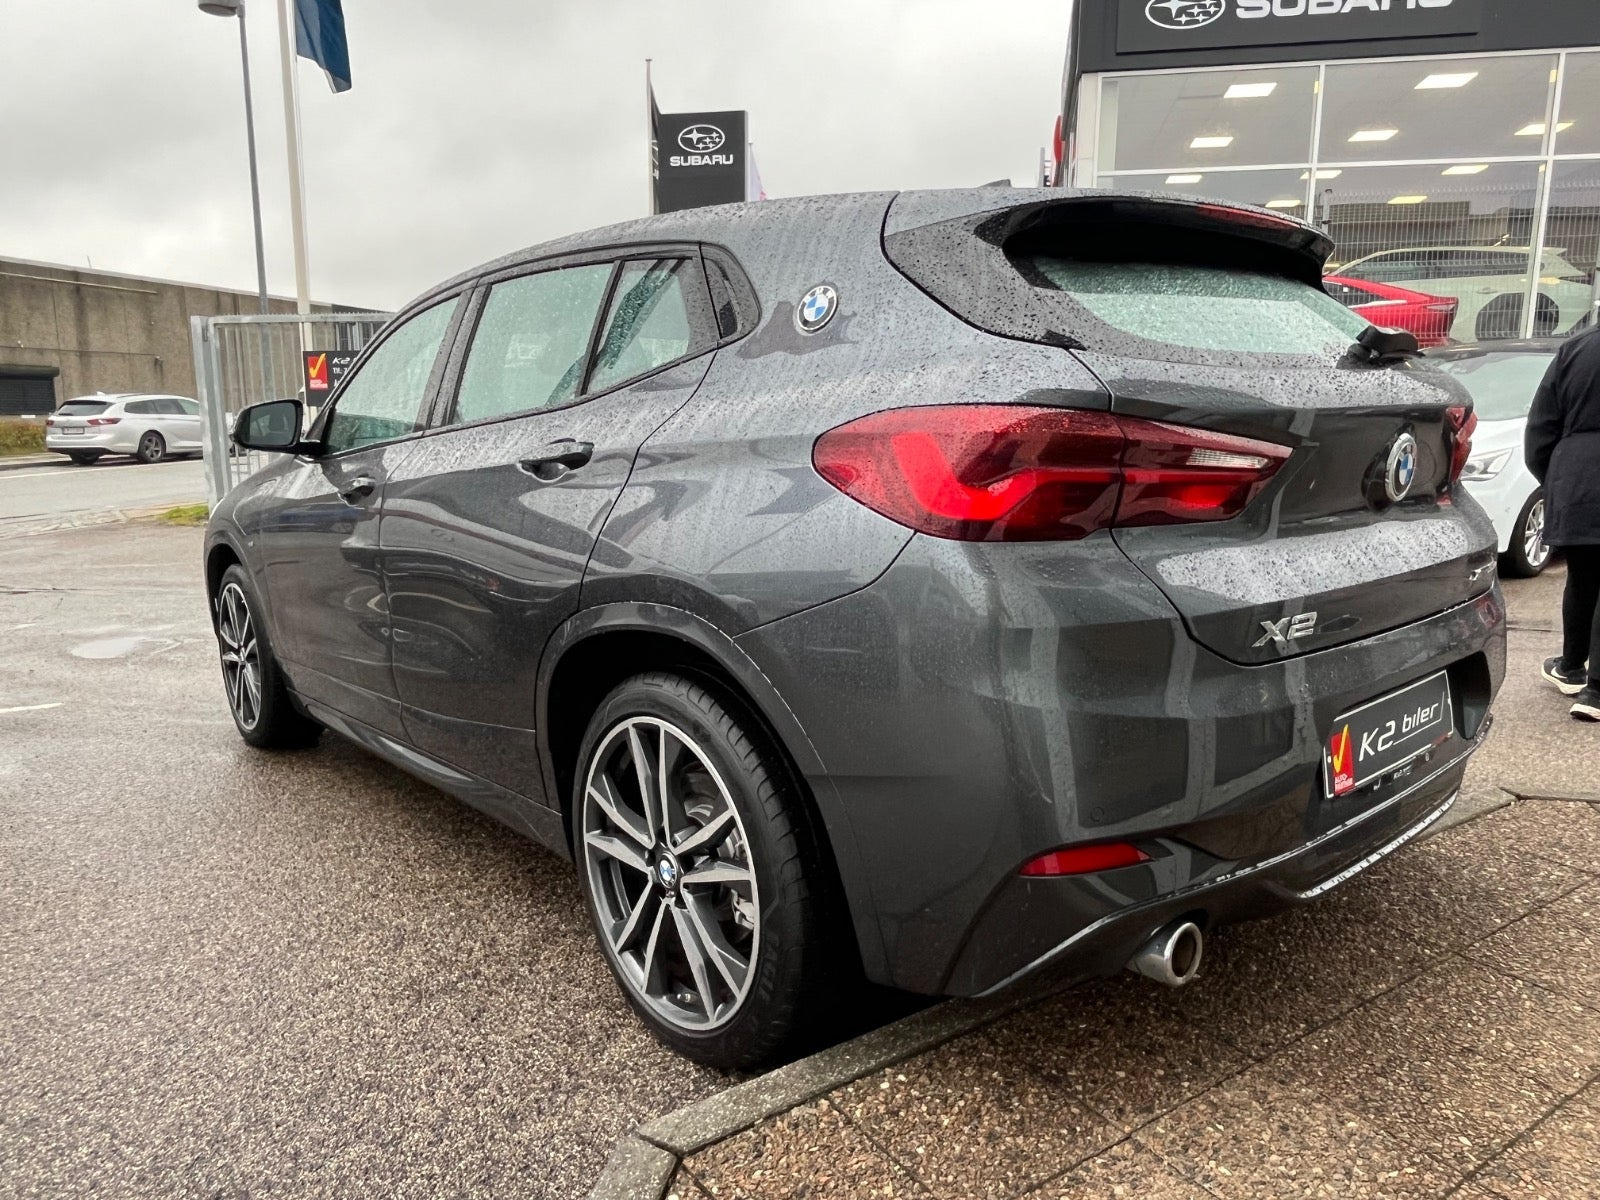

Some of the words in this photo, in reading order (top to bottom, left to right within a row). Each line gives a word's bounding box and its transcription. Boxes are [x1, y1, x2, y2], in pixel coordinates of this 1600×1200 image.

[1236, 0, 1453, 19] SUB
[669, 154, 734, 167] SUBARU
[332, 356, 351, 365] K2
[1251, 611, 1318, 648] X2
[1358, 720, 1396, 762] K2
